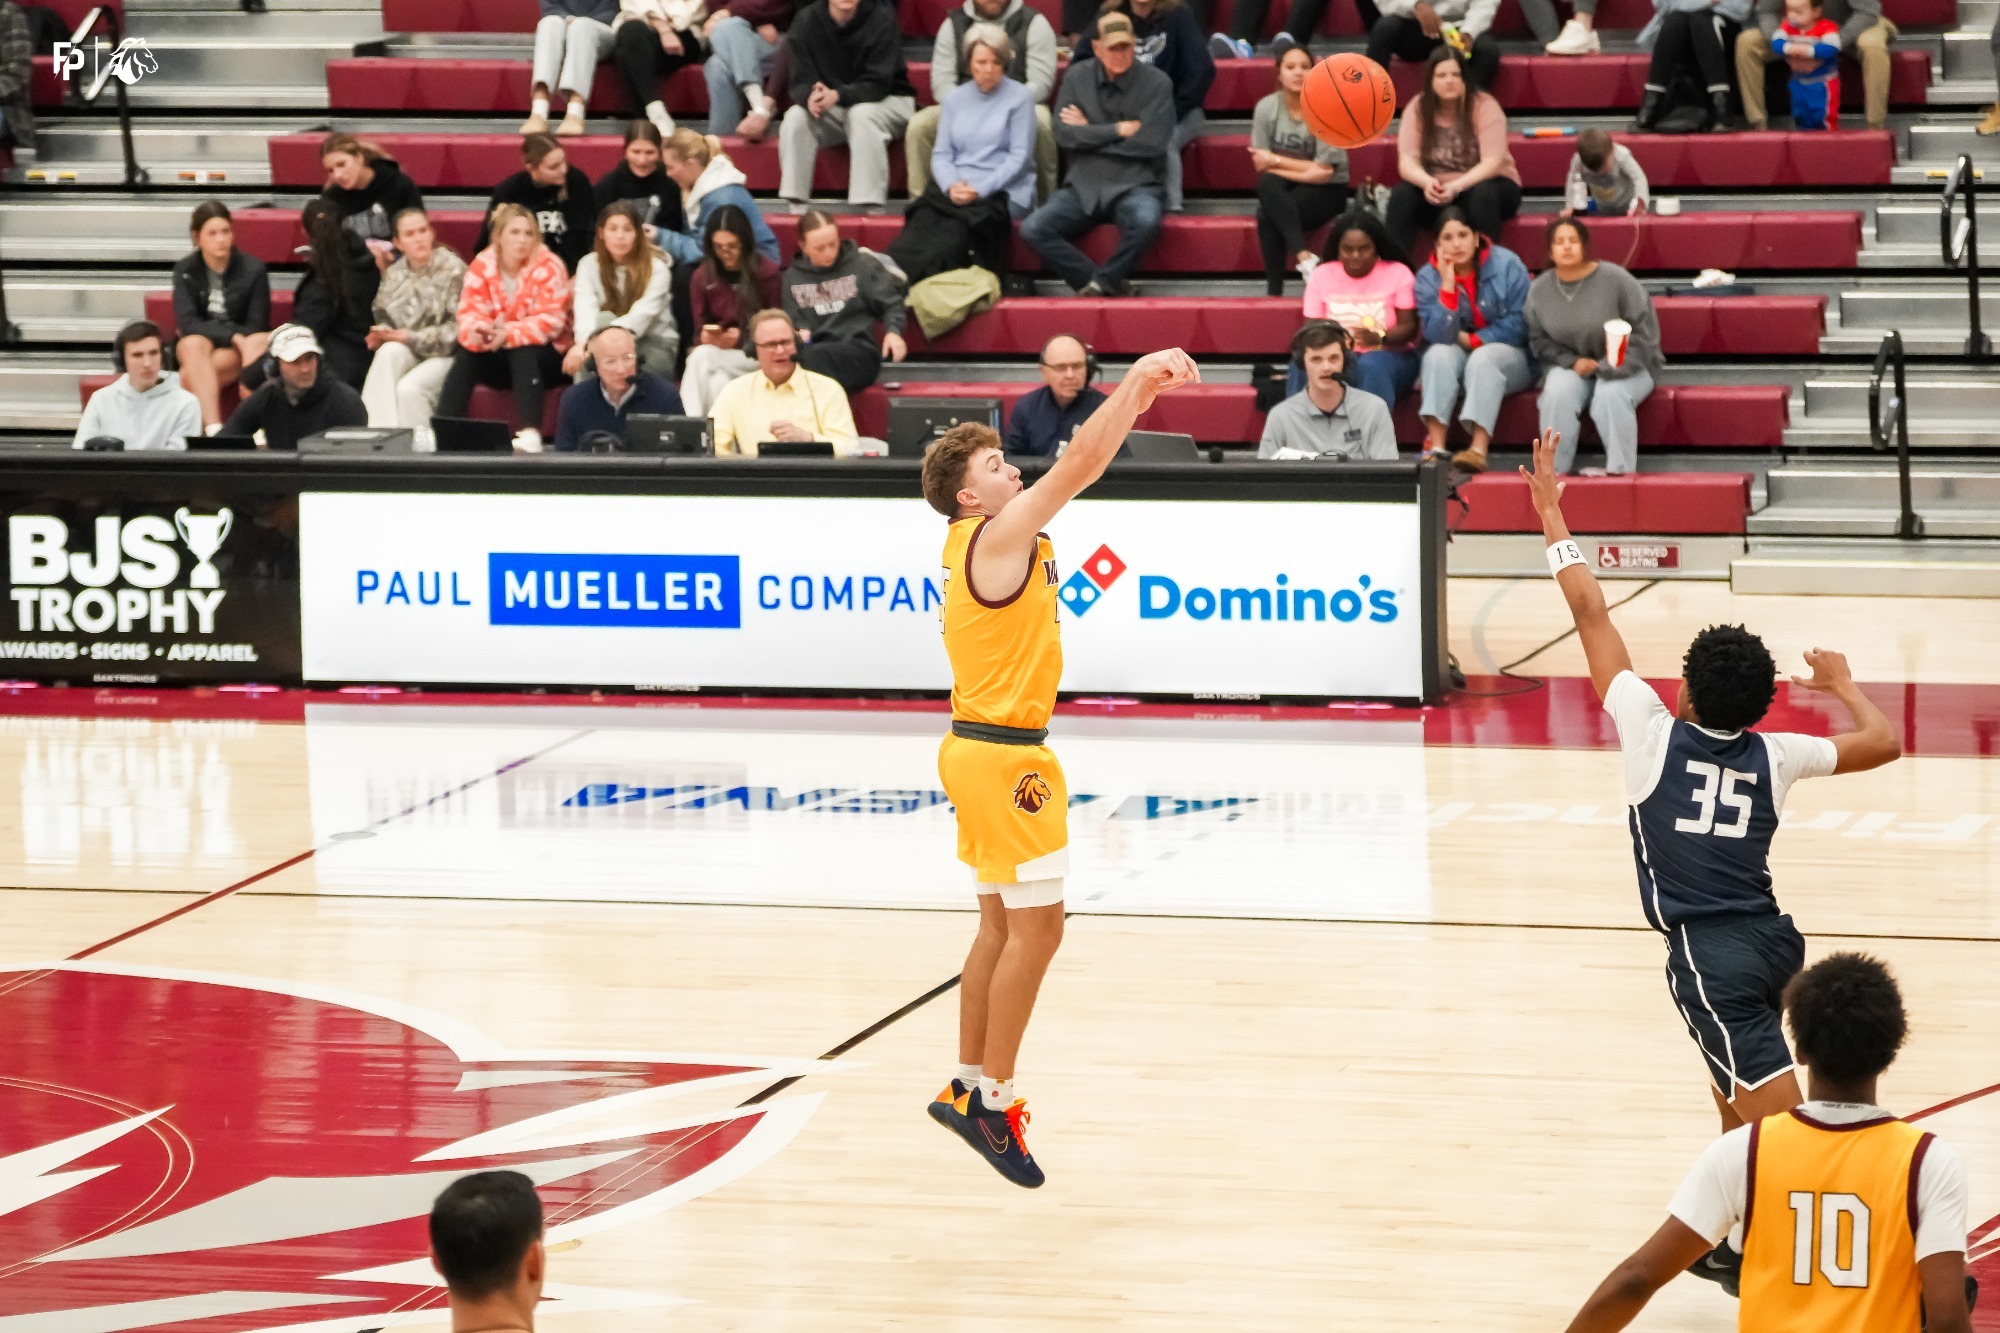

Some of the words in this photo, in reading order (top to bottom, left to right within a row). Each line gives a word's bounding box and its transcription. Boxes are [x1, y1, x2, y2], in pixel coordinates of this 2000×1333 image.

[8, 515, 181, 588] BJS
[1619, 546, 1668, 558] RESERVED
[1619, 558, 1659, 569] SEATING
[9, 587, 227, 634] TROPHY
[356, 570, 472, 606] PAUL
[503, 569, 724, 612] MUELLER
[758, 574, 942, 612] COMPAN
[1139, 573, 1399, 624] Domino's
[90, 642, 151, 661] SIGNS
[166, 643, 259, 662] APPAREL
[1674, 759, 1758, 839] 35
[1787, 1190, 1872, 1289] 10
